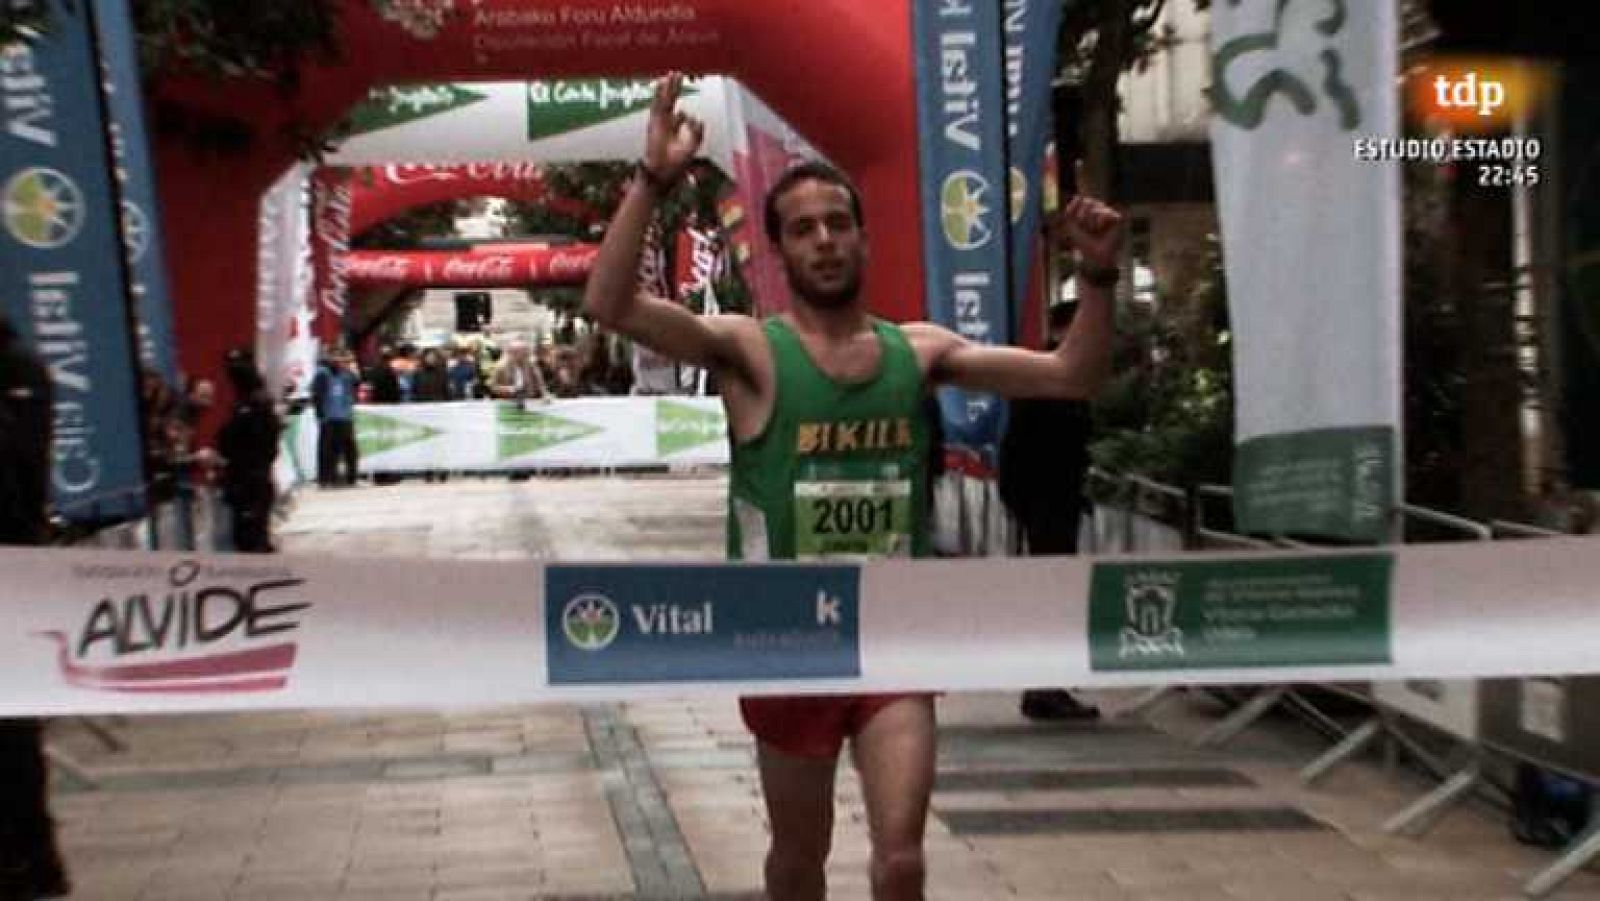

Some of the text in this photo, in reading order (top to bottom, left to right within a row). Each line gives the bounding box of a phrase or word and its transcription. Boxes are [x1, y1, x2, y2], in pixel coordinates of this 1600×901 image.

[813, 497, 894, 535] 2001
[76, 562, 313, 658] ALVIDE
[632, 600, 714, 635] Vital
